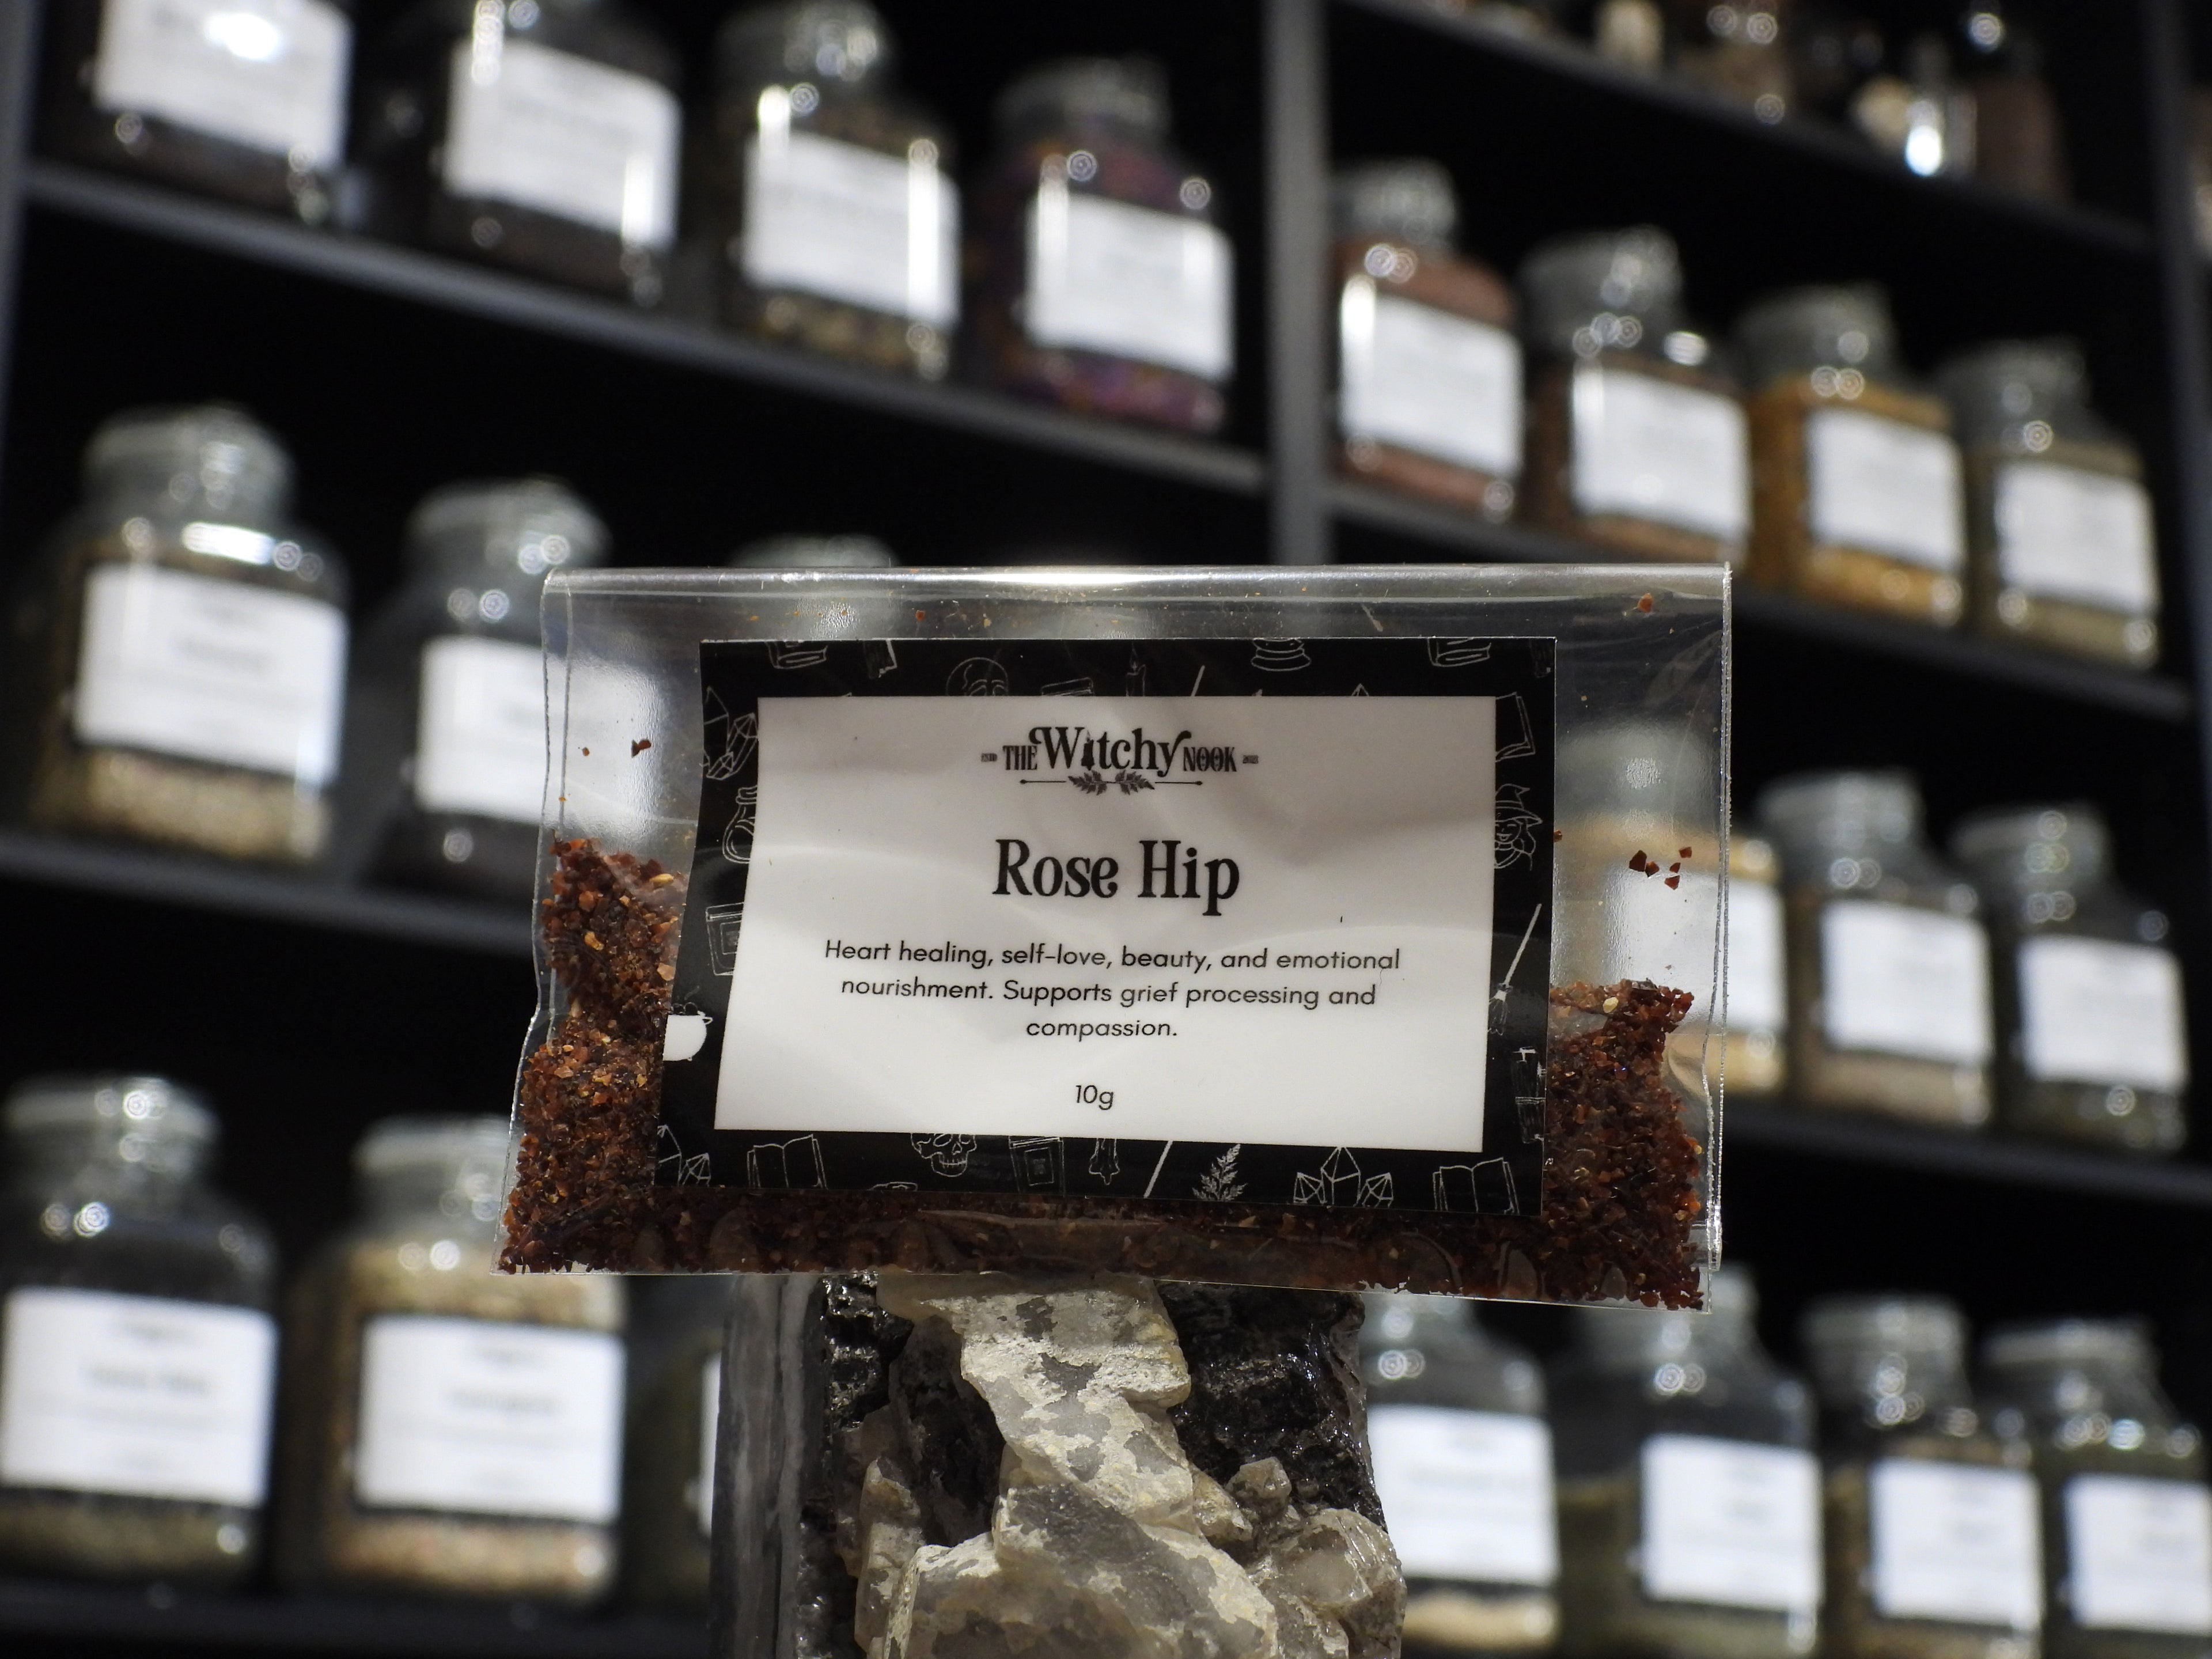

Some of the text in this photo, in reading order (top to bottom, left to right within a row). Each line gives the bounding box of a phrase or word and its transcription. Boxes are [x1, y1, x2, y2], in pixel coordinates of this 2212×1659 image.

[1002, 726, 1237, 778] THE Witchy NOOK
[992, 839, 1240, 917] Rose Hip
[825, 940, 1400, 975] Heart healing, self-love, beauty, and emotional
[841, 976, 1377, 1011] nourishment. Supports grief processing and
[1026, 1020, 1177, 1042] compassion.
[1075, 1084, 1115, 1111] 10g
